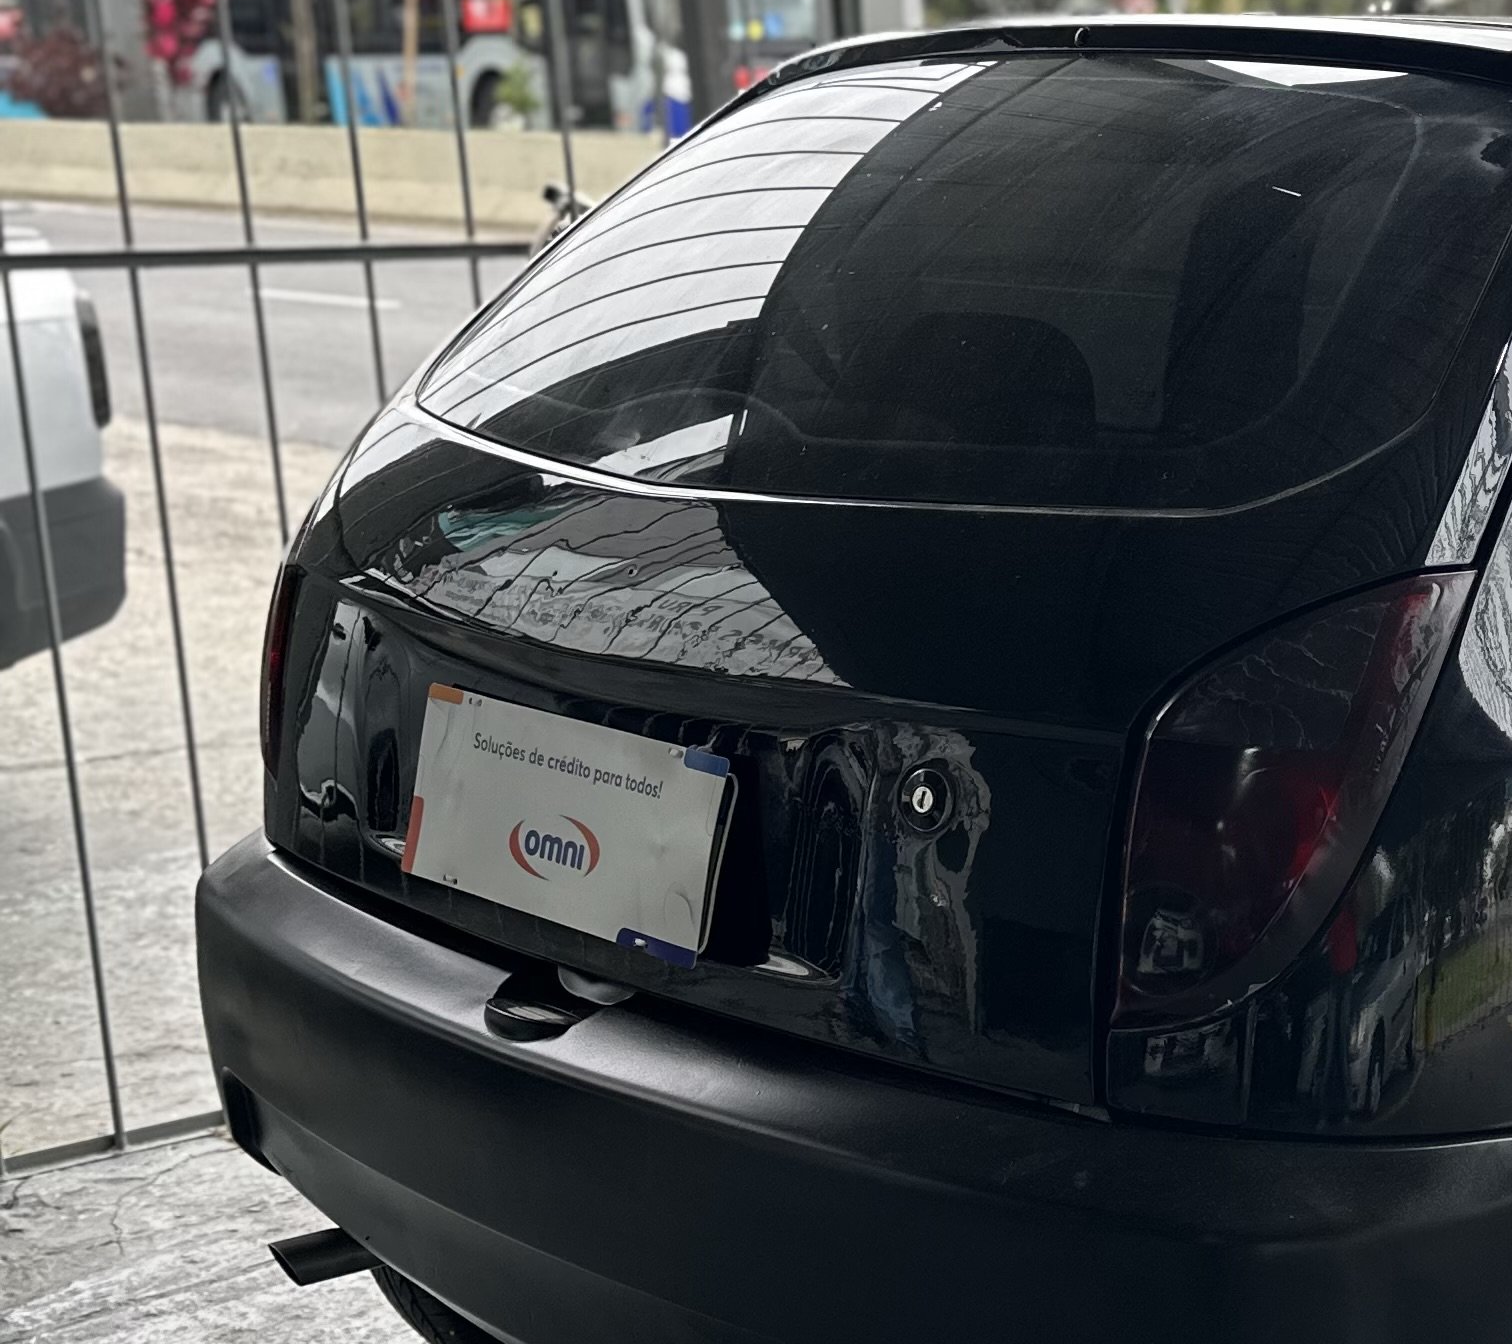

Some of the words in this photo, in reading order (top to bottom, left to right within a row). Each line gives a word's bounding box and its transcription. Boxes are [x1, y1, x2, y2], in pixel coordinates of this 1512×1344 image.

[473, 733, 526, 762] Soluções
[528, 746, 545, 767] de
[547, 755, 591, 780] crédito
[593, 767, 623, 788] para
[625, 773, 664, 800] todos!
[524, 829, 585, 871] omni
